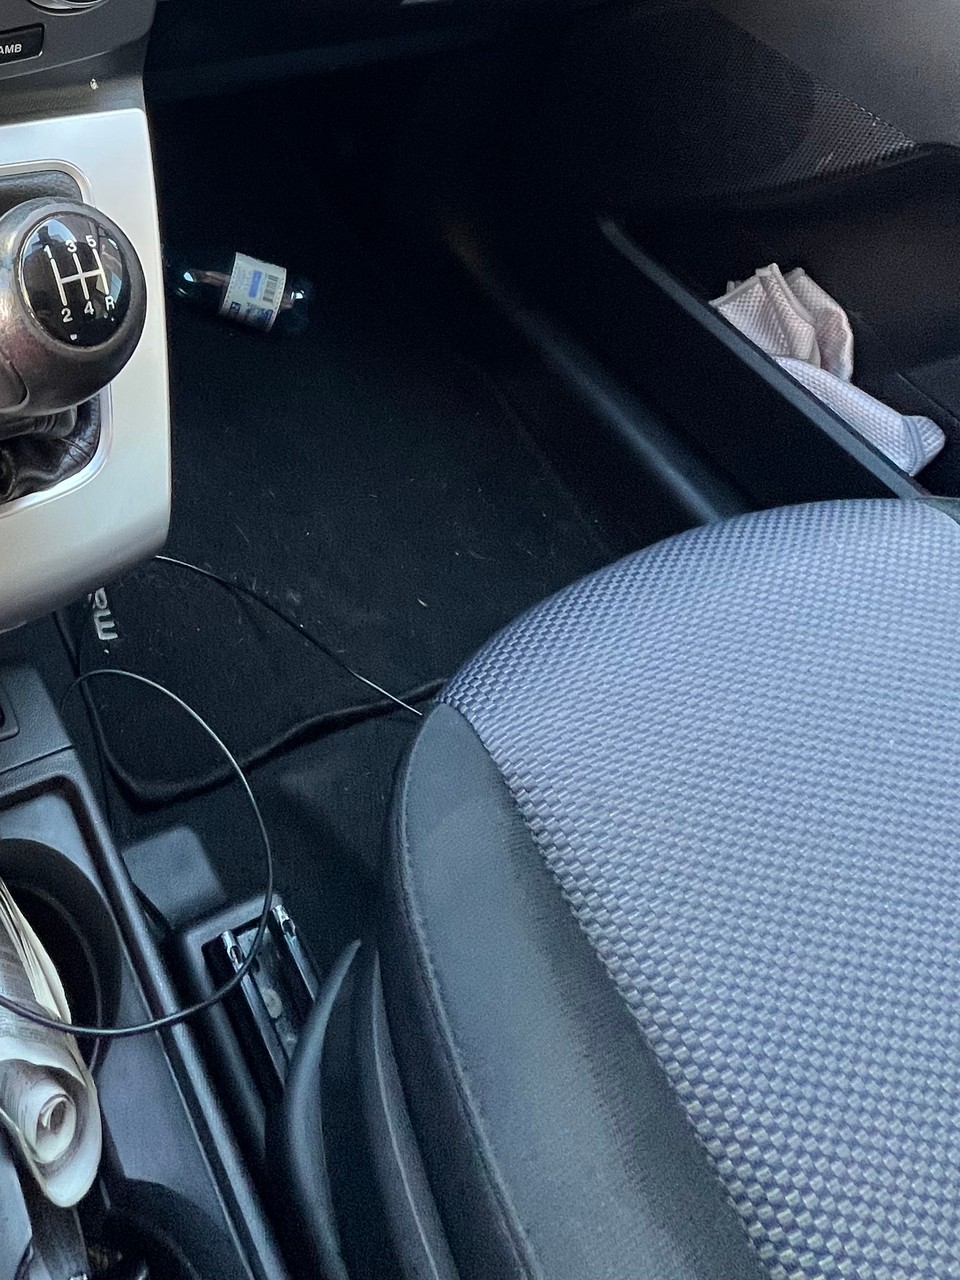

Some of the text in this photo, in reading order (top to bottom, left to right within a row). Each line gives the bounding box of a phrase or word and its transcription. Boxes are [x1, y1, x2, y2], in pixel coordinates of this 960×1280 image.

[43, 234, 97, 259] 1 3 5
[61, 295, 115, 323] 2 4 R
